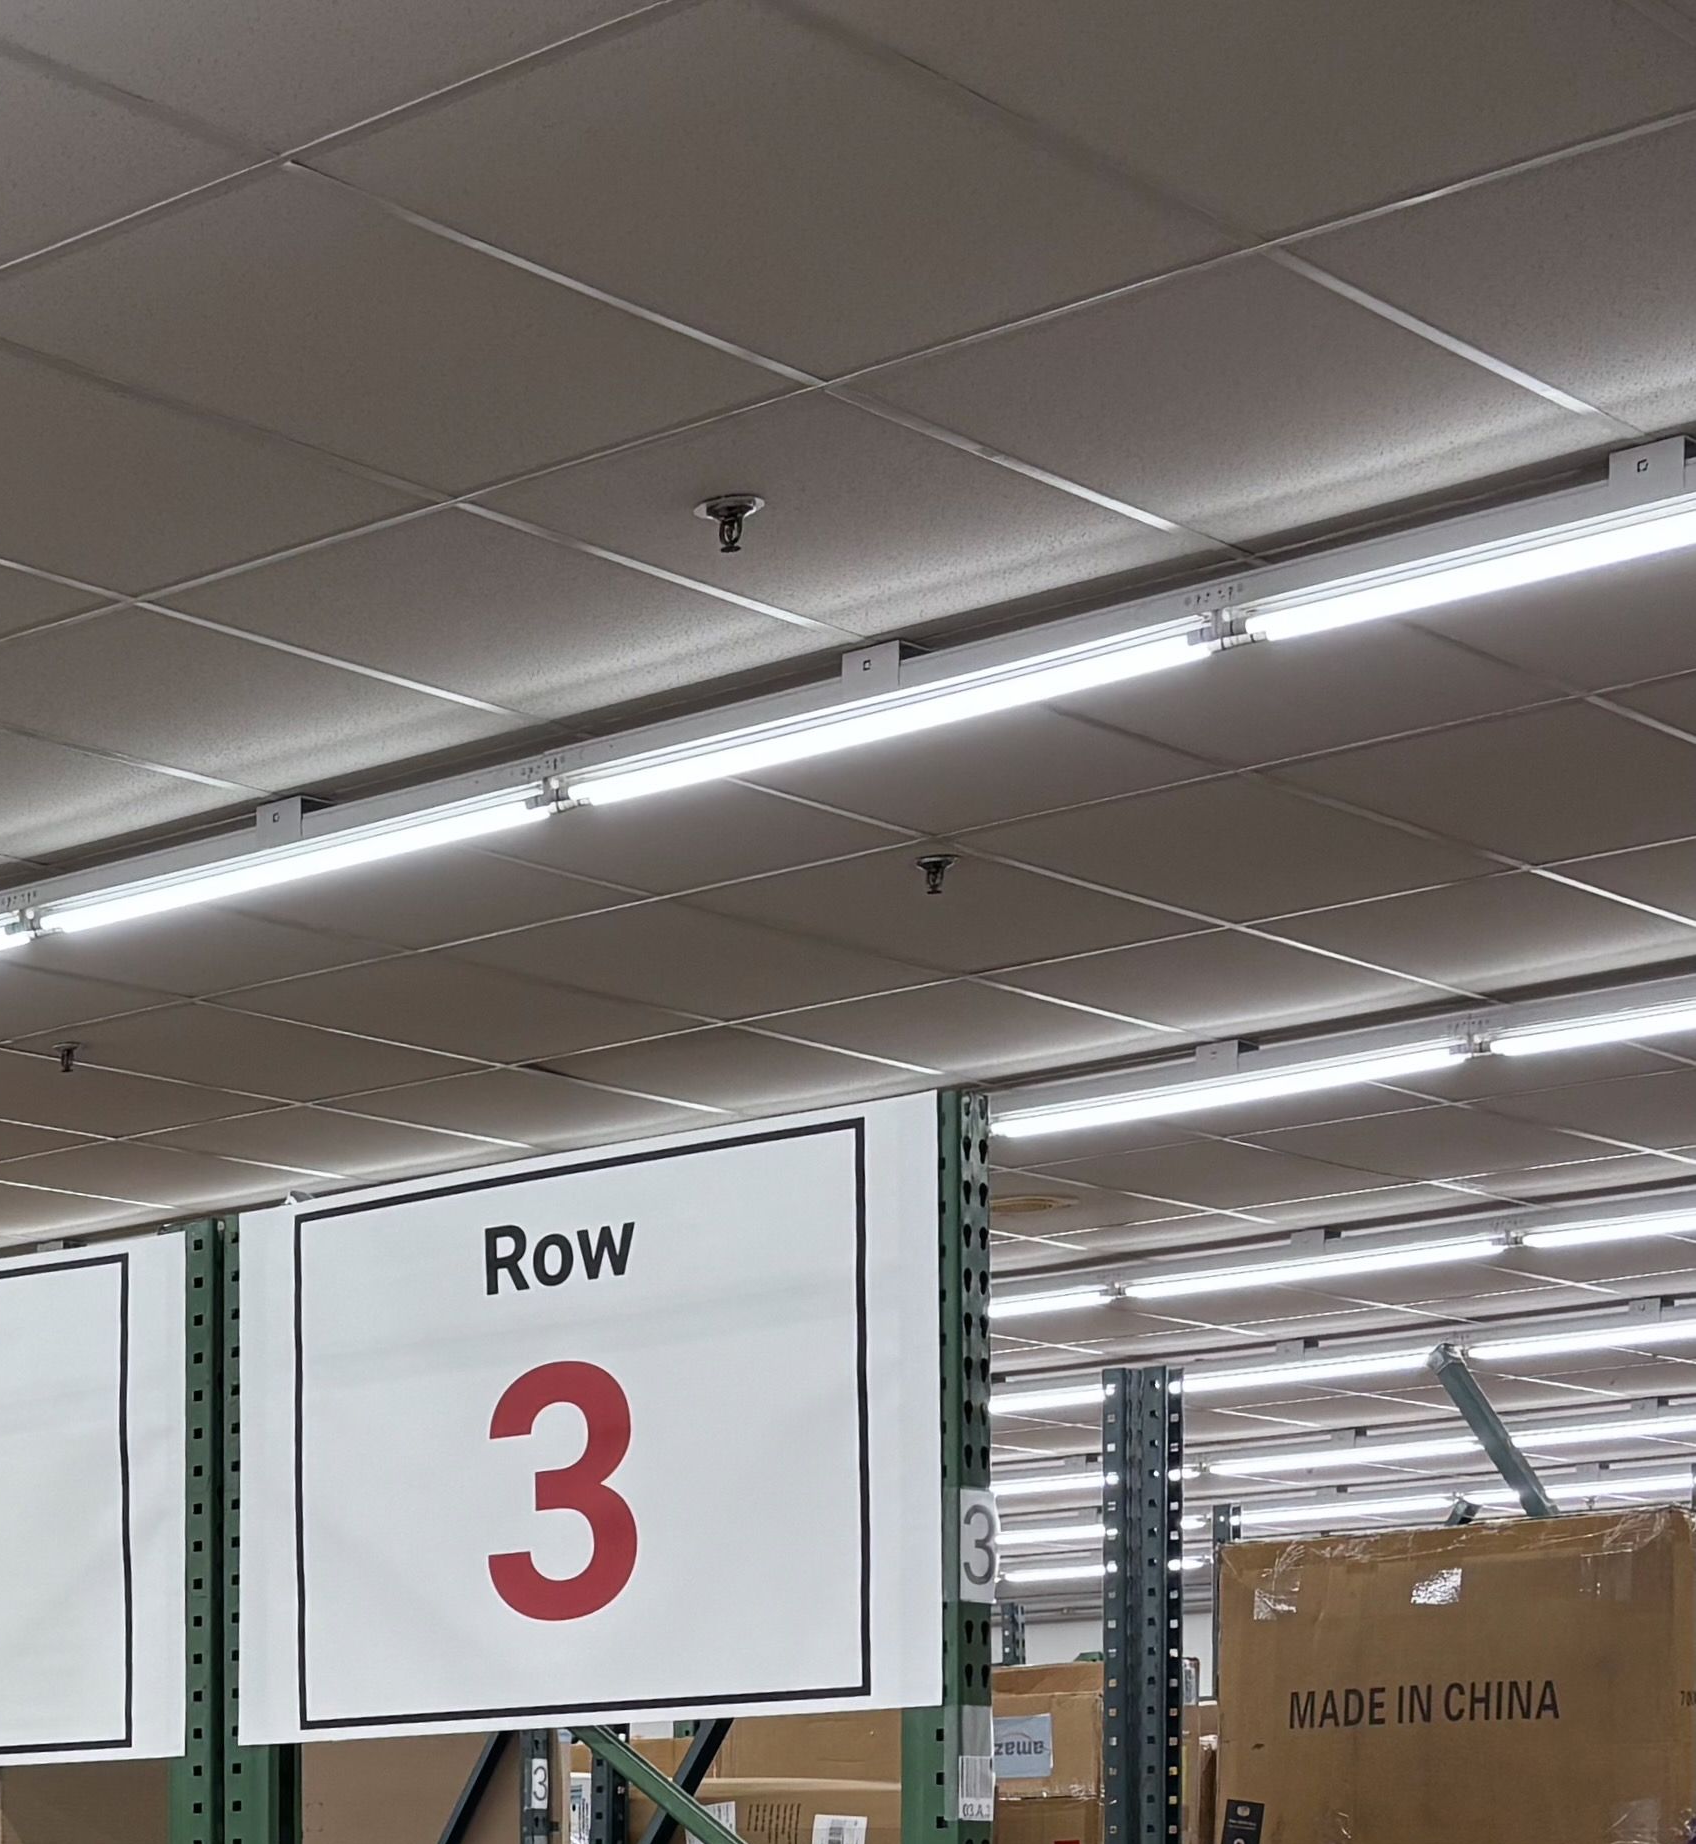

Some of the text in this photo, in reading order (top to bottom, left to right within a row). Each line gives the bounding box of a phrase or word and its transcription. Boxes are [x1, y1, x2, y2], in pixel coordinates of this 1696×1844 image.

[483, 1221, 636, 1297] Row
[487, 1359, 639, 1622] 3
[963, 1503, 996, 1585] 3
[1289, 1679, 1560, 1729] MADE IN CHINA
[532, 1766, 548, 1801] 3
